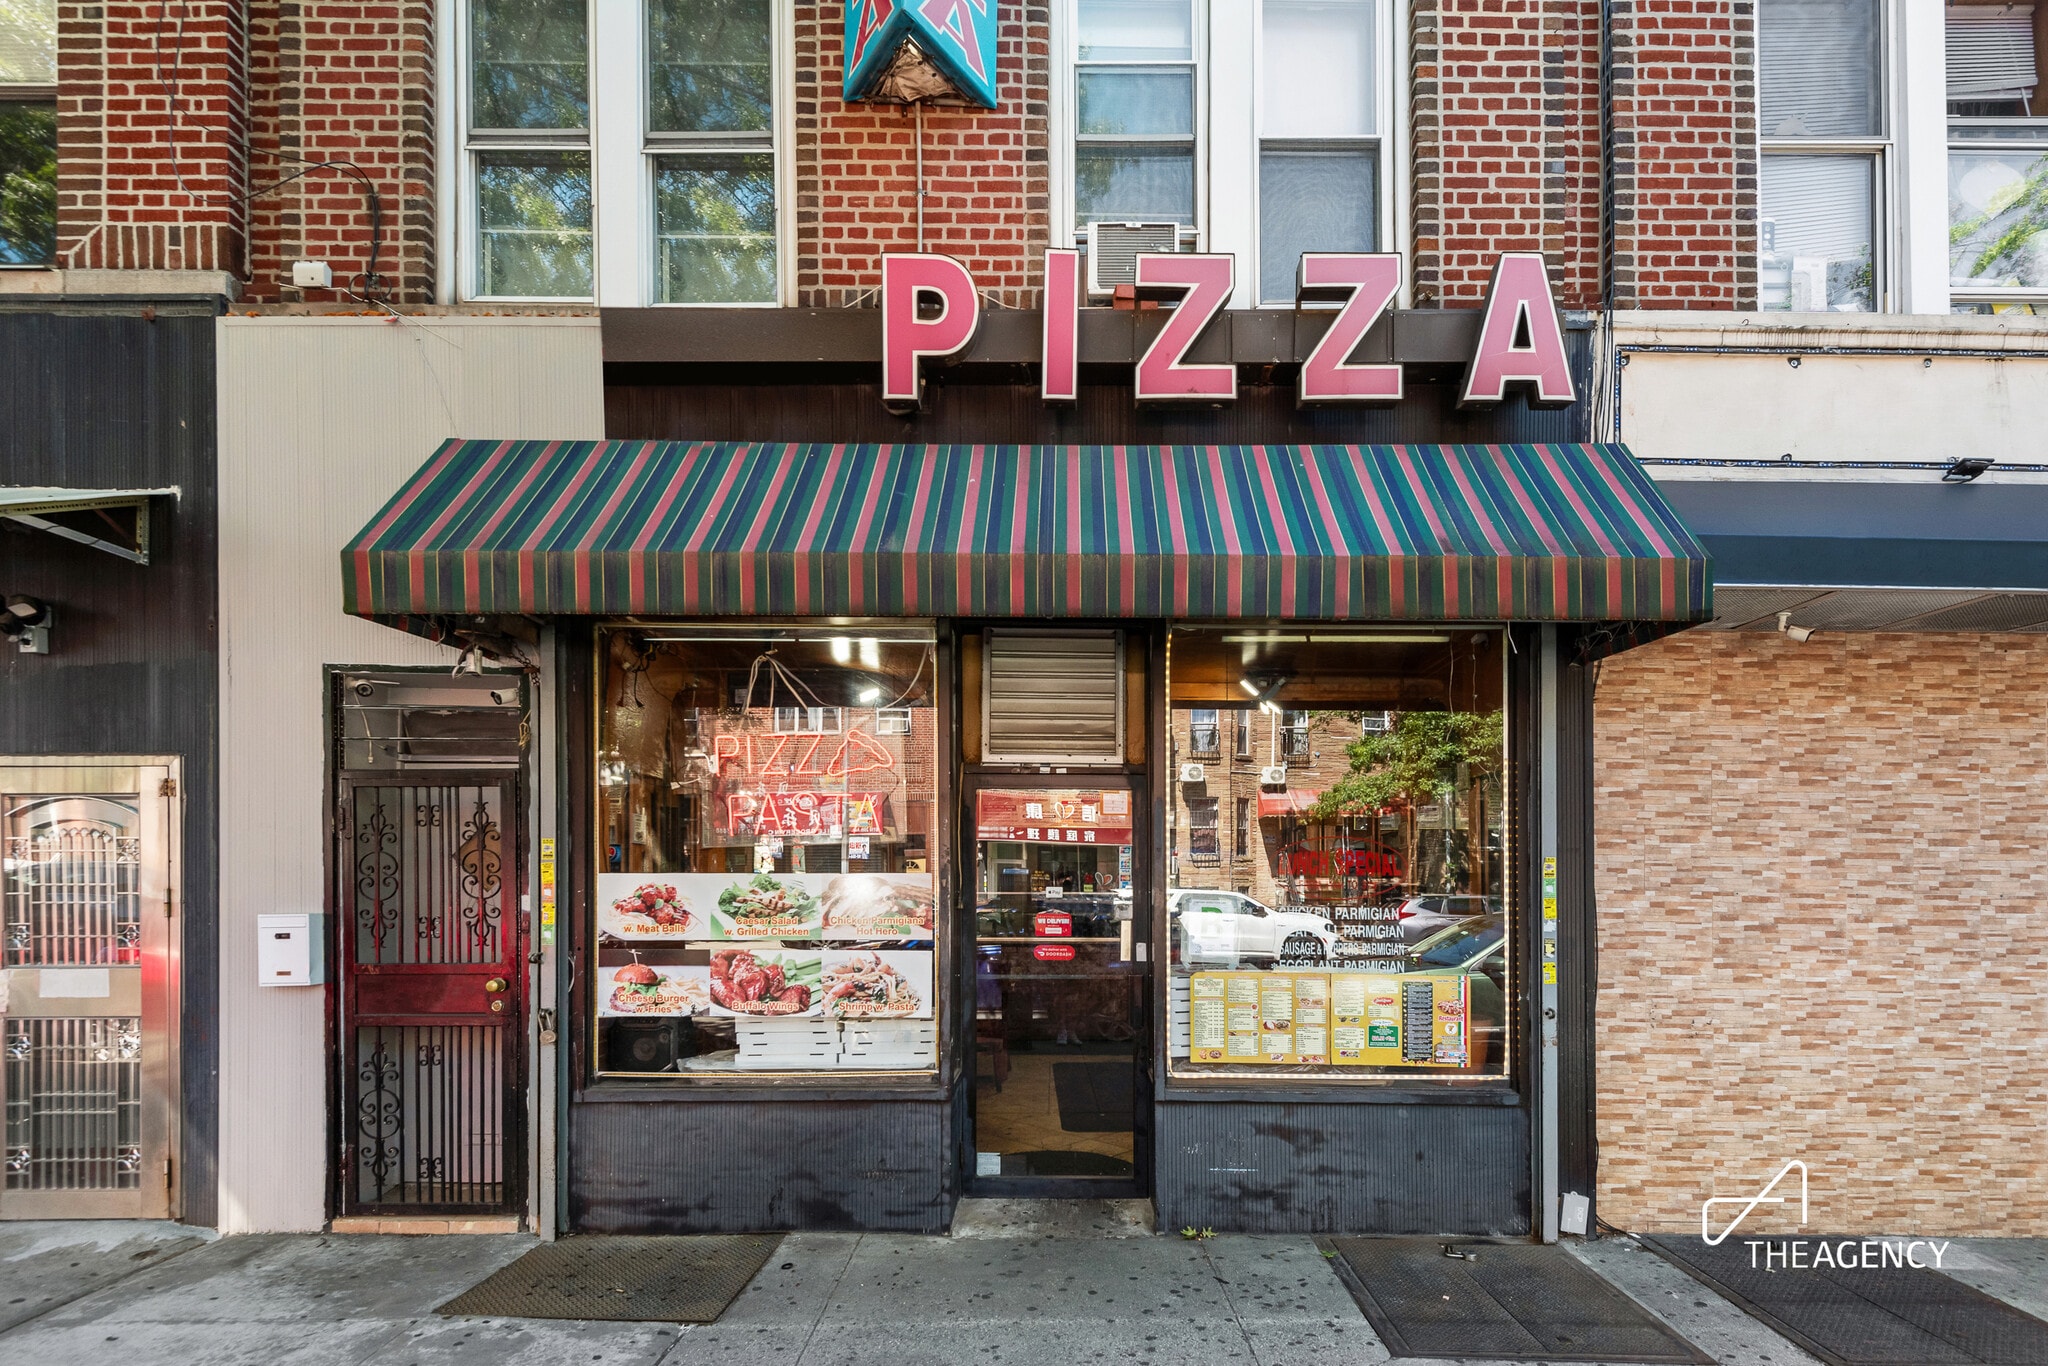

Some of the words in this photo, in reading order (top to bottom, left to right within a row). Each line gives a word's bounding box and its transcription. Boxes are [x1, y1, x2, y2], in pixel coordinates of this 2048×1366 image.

[881, 249, 1577, 406] PIZZA
[728, 792, 883, 837] PASTA
[1278, 850, 1329, 877] LUNCH
[1335, 848, 1402, 877] SPECIAL
[1335, 907, 1400, 920] PARMIGIAN
[735, 917, 769, 925] Caesar
[771, 917, 798, 925] Salad
[830, 917, 870, 925] Chicken
[871, 917, 924, 927] Parmigiana
[637, 924, 659, 933] Meat
[662, 924, 686, 933] Balls
[736, 928, 768, 936] Grilled
[771, 928, 809, 936] Chicken
[856, 928, 873, 936] Hot
[875, 928, 899, 936] Hero
[1344, 925, 1404, 938] PARMIGIAN
[1280, 942, 1316, 955] SAUSAGE
[618, 994, 655, 1003] Cheese
[656, 994, 689, 1005] Burger
[732, 1001, 767, 1010] Buffalo
[769, 1001, 799, 1012] Wings
[839, 1002, 873, 1012] Shrimp
[888, 1002, 916, 1011] Pasta
